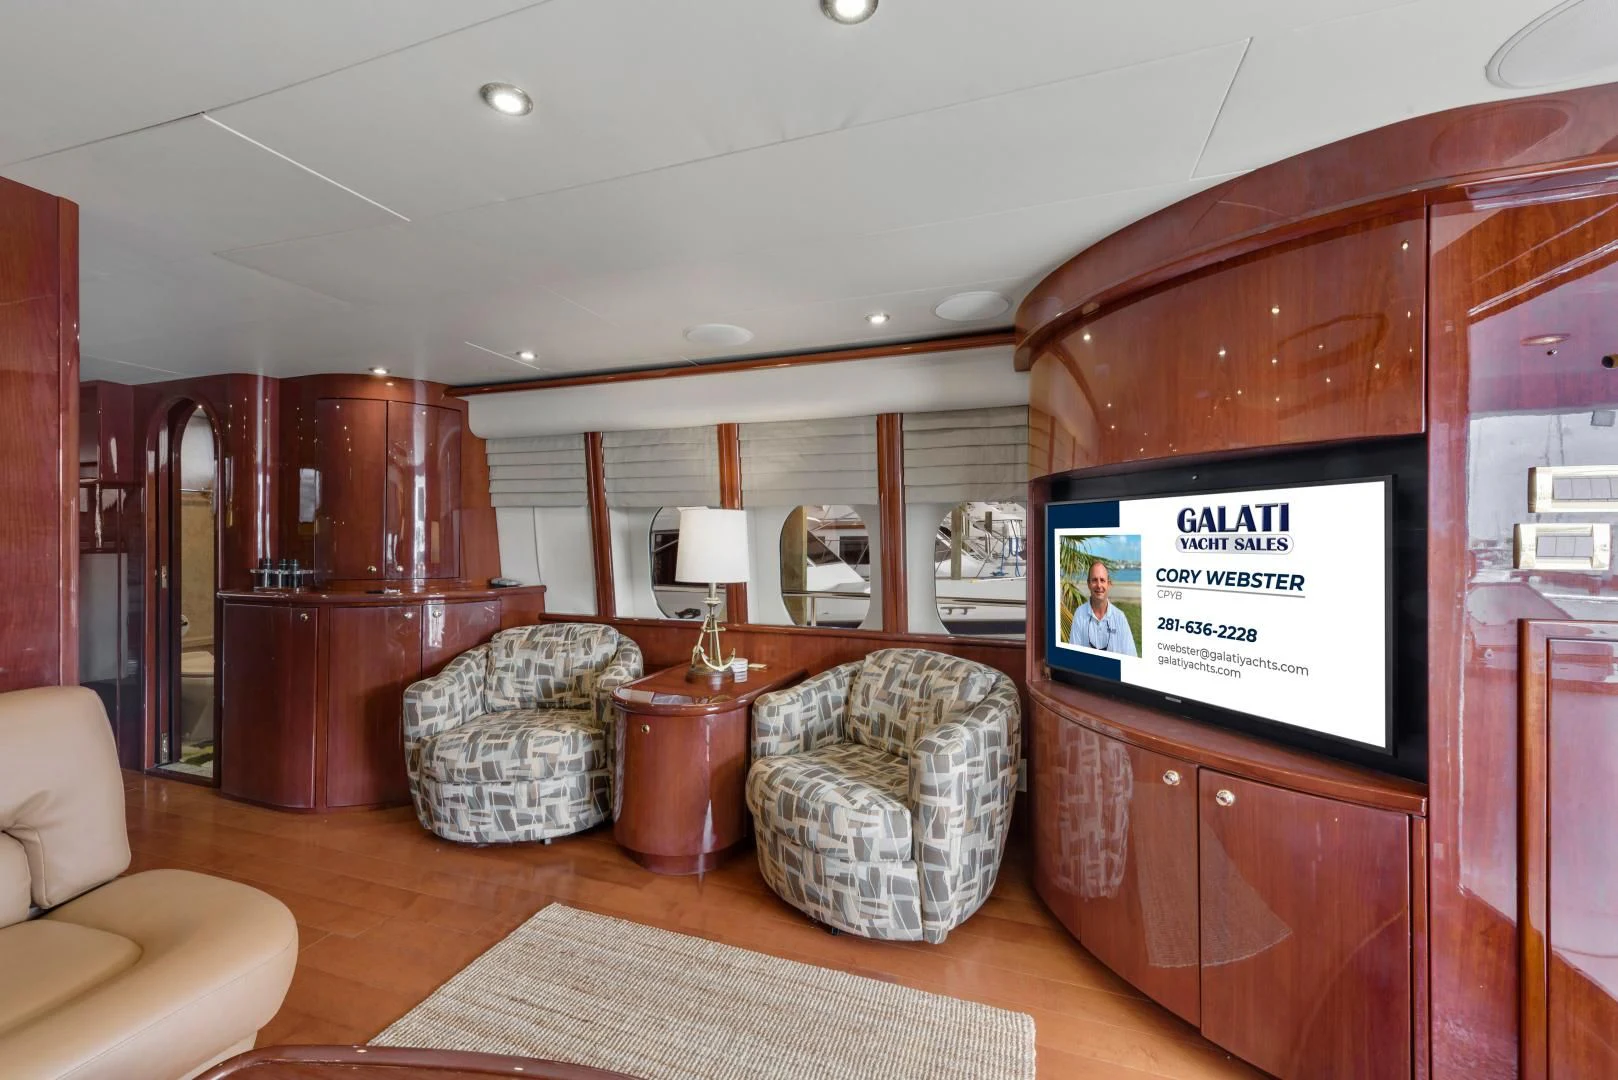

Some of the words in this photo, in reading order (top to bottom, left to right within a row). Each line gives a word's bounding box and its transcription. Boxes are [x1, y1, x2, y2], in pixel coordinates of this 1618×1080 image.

[1177, 502, 1290, 533] GALATI
[1180, 537, 1229, 551] YACHT
[1234, 537, 1289, 552] SALES
[1156, 567, 1202, 584] CORY
[1206, 570, 1305, 591] WEBSTER
[1157, 589, 1183, 601] CPYB
[1157, 616, 1258, 643] 281-636-2228
[1157, 641, 1309, 677] cwebster@galatiyachts.com
[1157, 654, 1242, 679] galatiyachts.com
